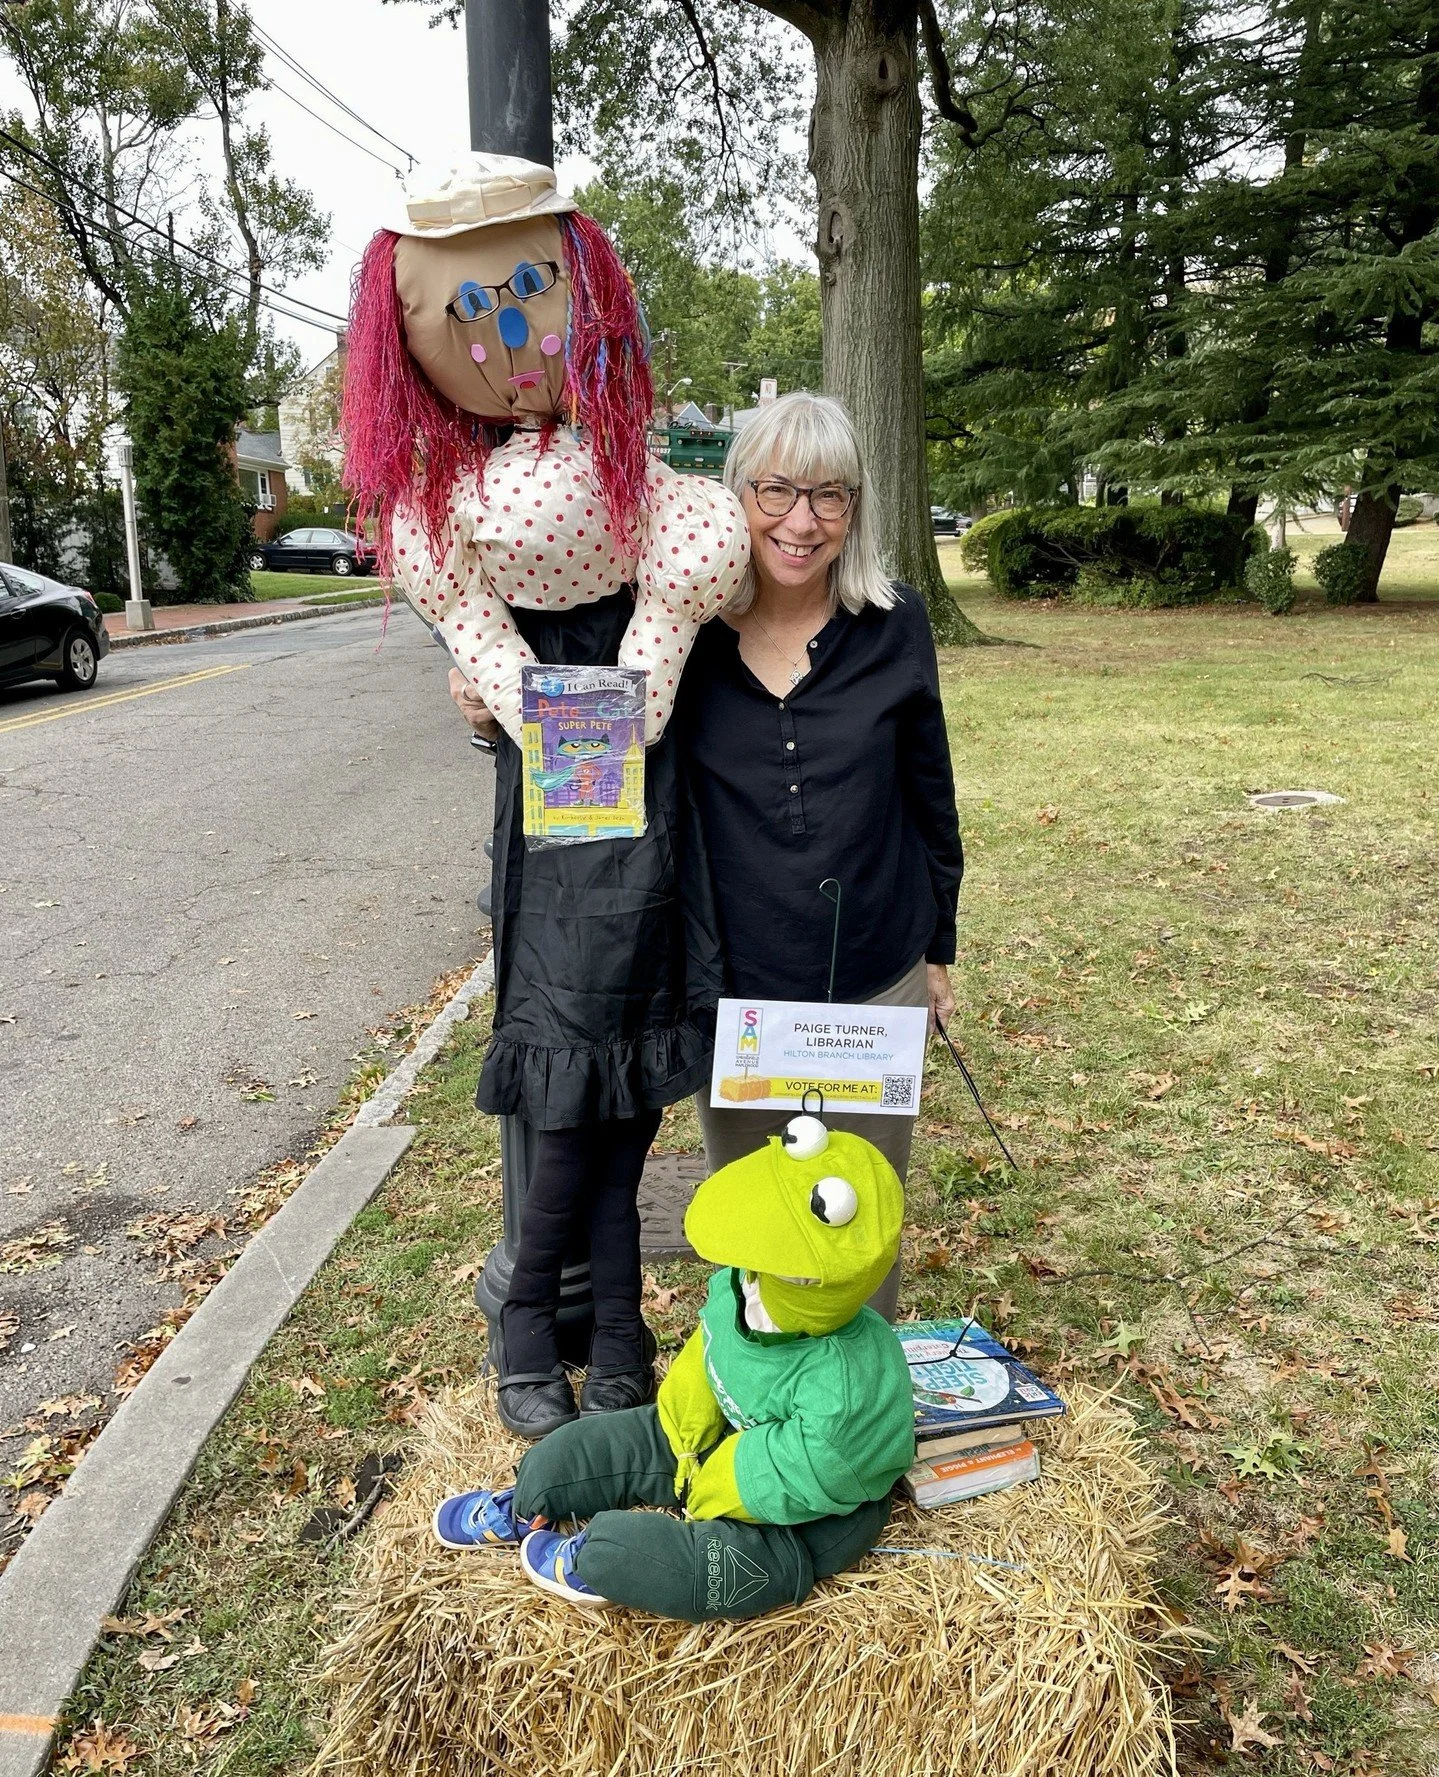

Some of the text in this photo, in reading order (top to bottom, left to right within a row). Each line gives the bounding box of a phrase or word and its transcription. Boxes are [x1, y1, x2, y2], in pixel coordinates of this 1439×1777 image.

[567, 679, 629, 692] I Can Read!
[537, 698, 580, 718] Pete
[558, 721, 613, 731] SUPER PETE
[740, 1010, 758, 1052] SAM
[794, 1023, 888, 1037] PAIGE TURNER,
[806, 1037, 874, 1049] LIBRARIAN
[784, 1050, 894, 1062] HILTON BRANCH LIBRARY
[785, 1081, 878, 1094] VOTE FOR ME AT:
[925, 1372, 988, 1390] SLEEP
[975, 1449, 1015, 1464] ELEPHANT
[940, 1463, 968, 1473] PIGGIE
[705, 1536, 724, 1612] Reebok
